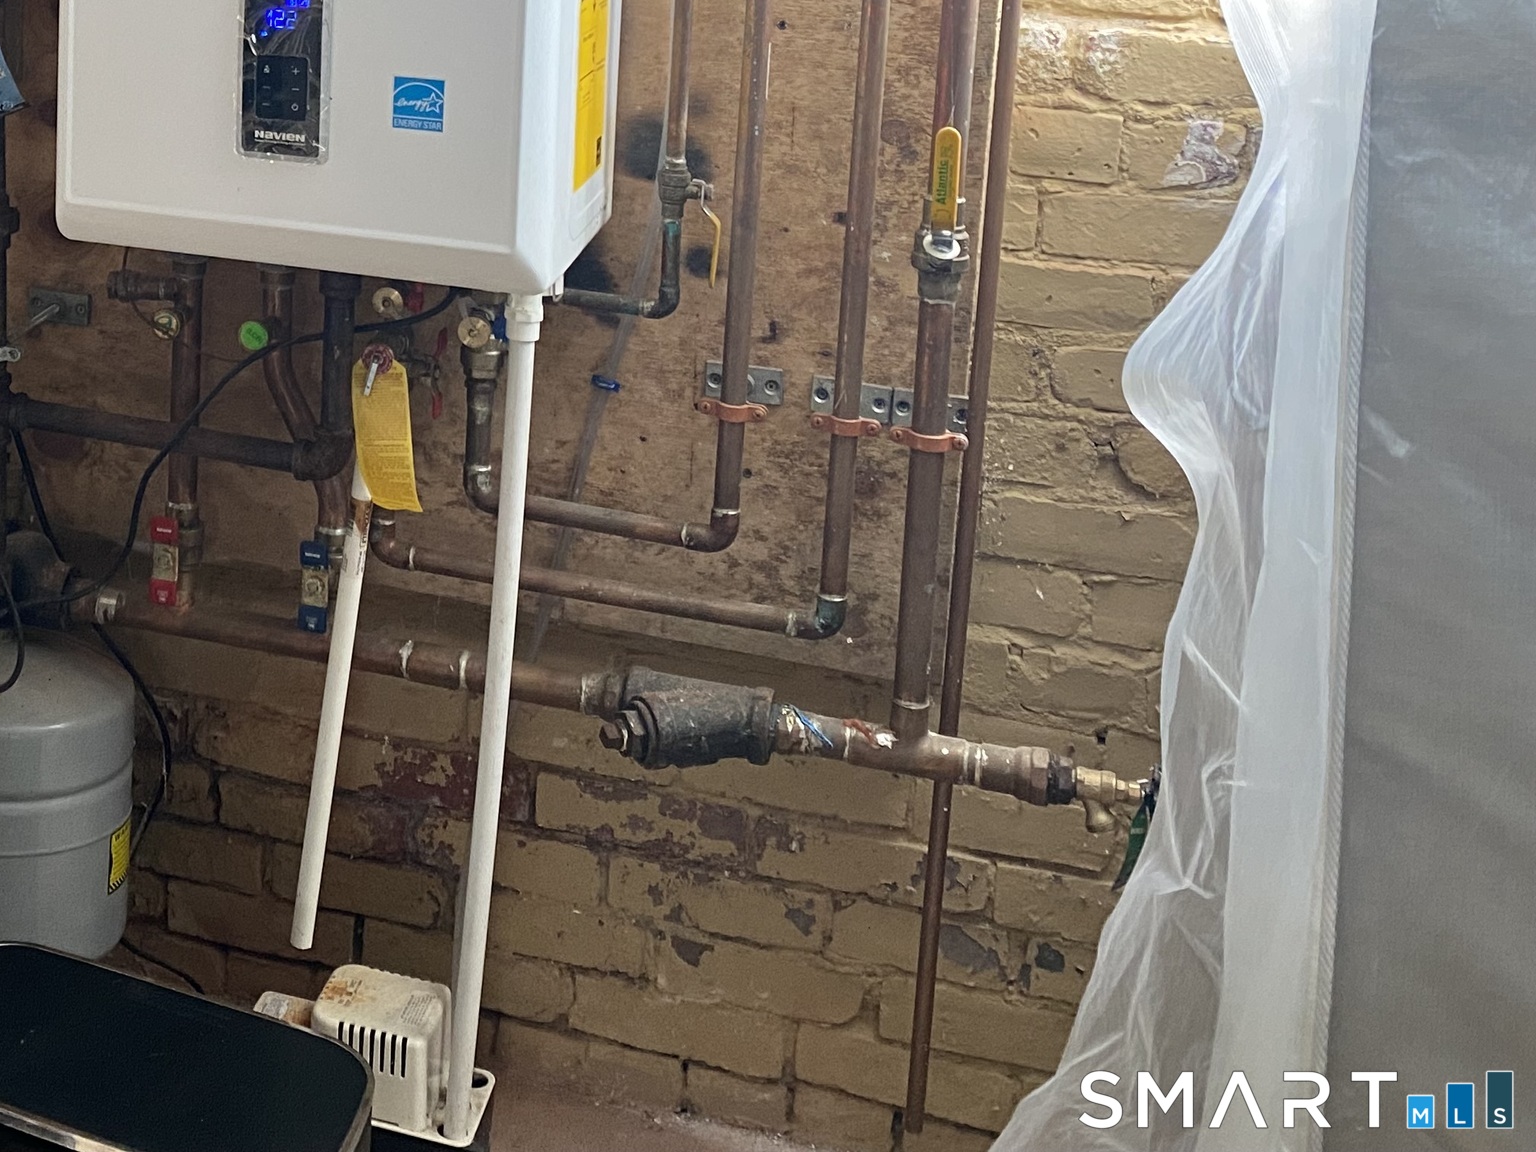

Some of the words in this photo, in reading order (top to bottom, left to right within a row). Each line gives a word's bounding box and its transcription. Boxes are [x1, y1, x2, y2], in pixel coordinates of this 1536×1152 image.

[394, 118, 423, 129] ENERGY
[422, 121, 442, 131] STAR
[935, 159, 949, 206] Atlantic
